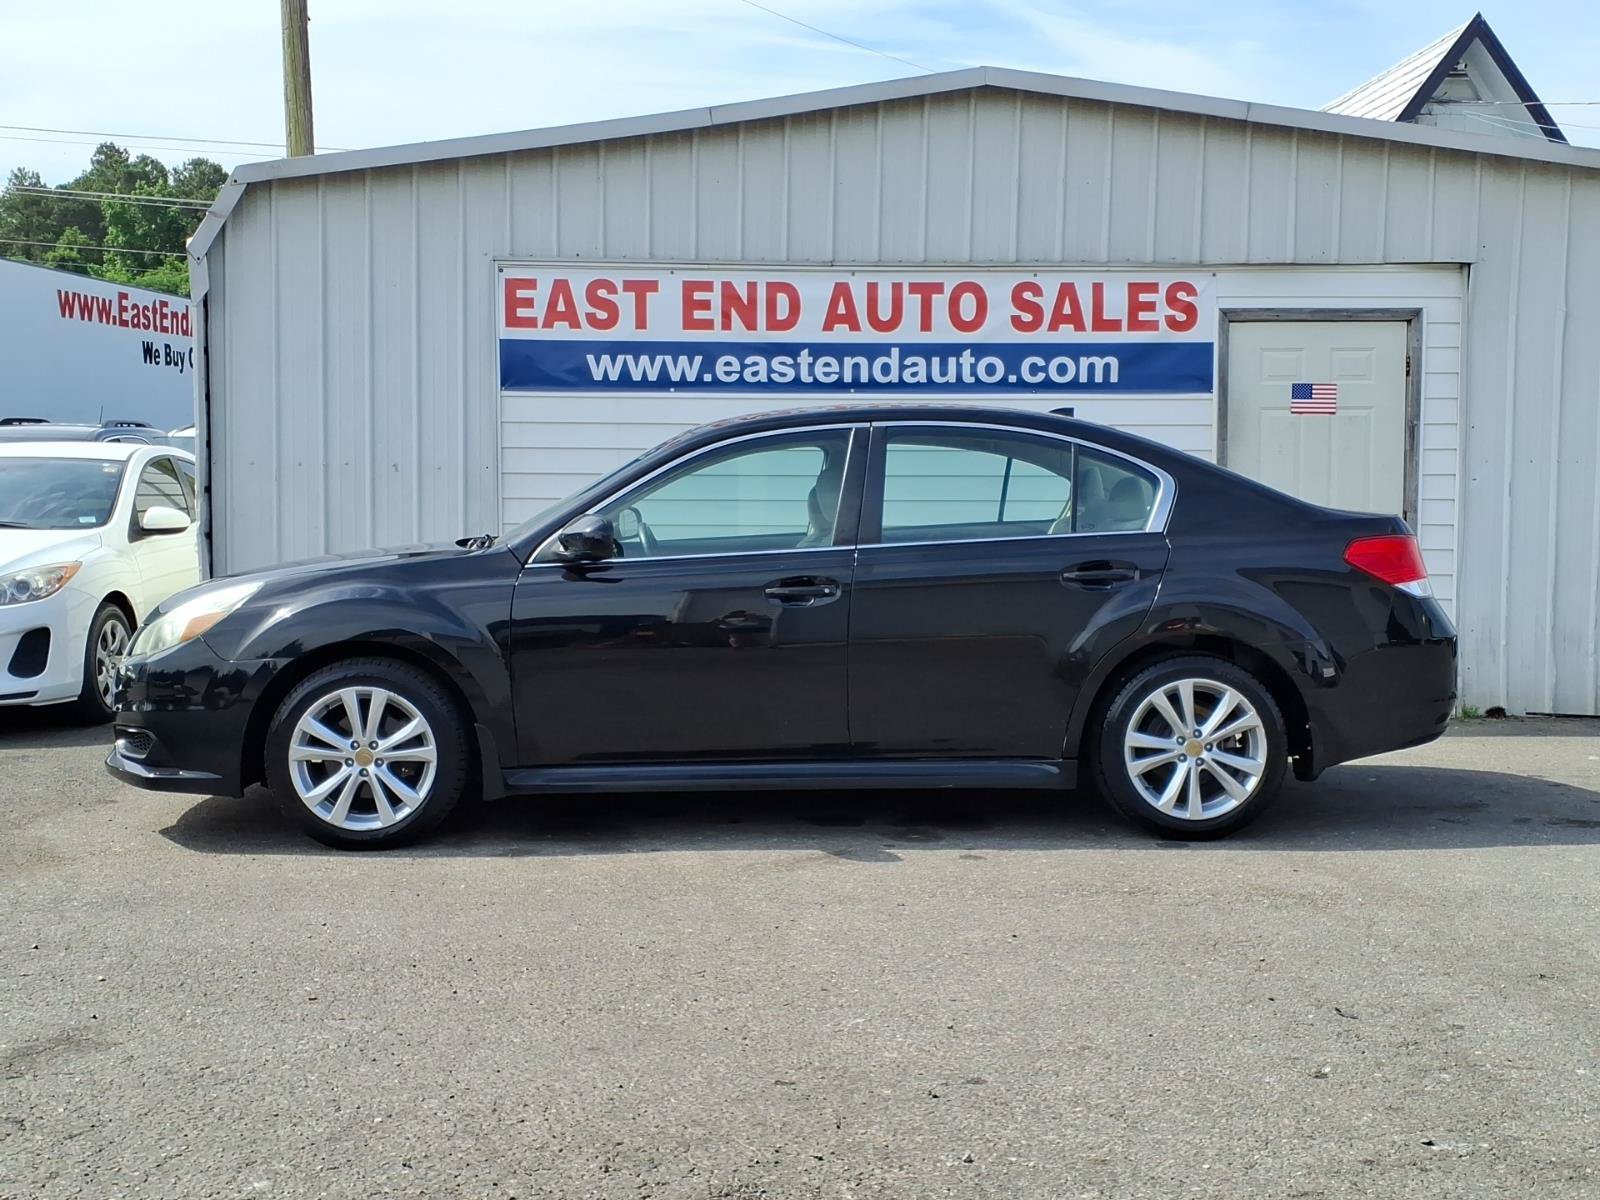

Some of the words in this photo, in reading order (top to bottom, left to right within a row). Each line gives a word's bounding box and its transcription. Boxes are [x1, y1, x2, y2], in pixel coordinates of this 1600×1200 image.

[57, 289, 192, 337] www.EastEnd
[504, 278, 660, 331] EAST
[681, 280, 802, 332] END
[821, 281, 989, 333] AUTO
[1009, 281, 1199, 333] SALES
[142, 340, 161, 366] We
[164, 343, 185, 374] Buy
[586, 348, 1119, 384] www.eastendauto.com
